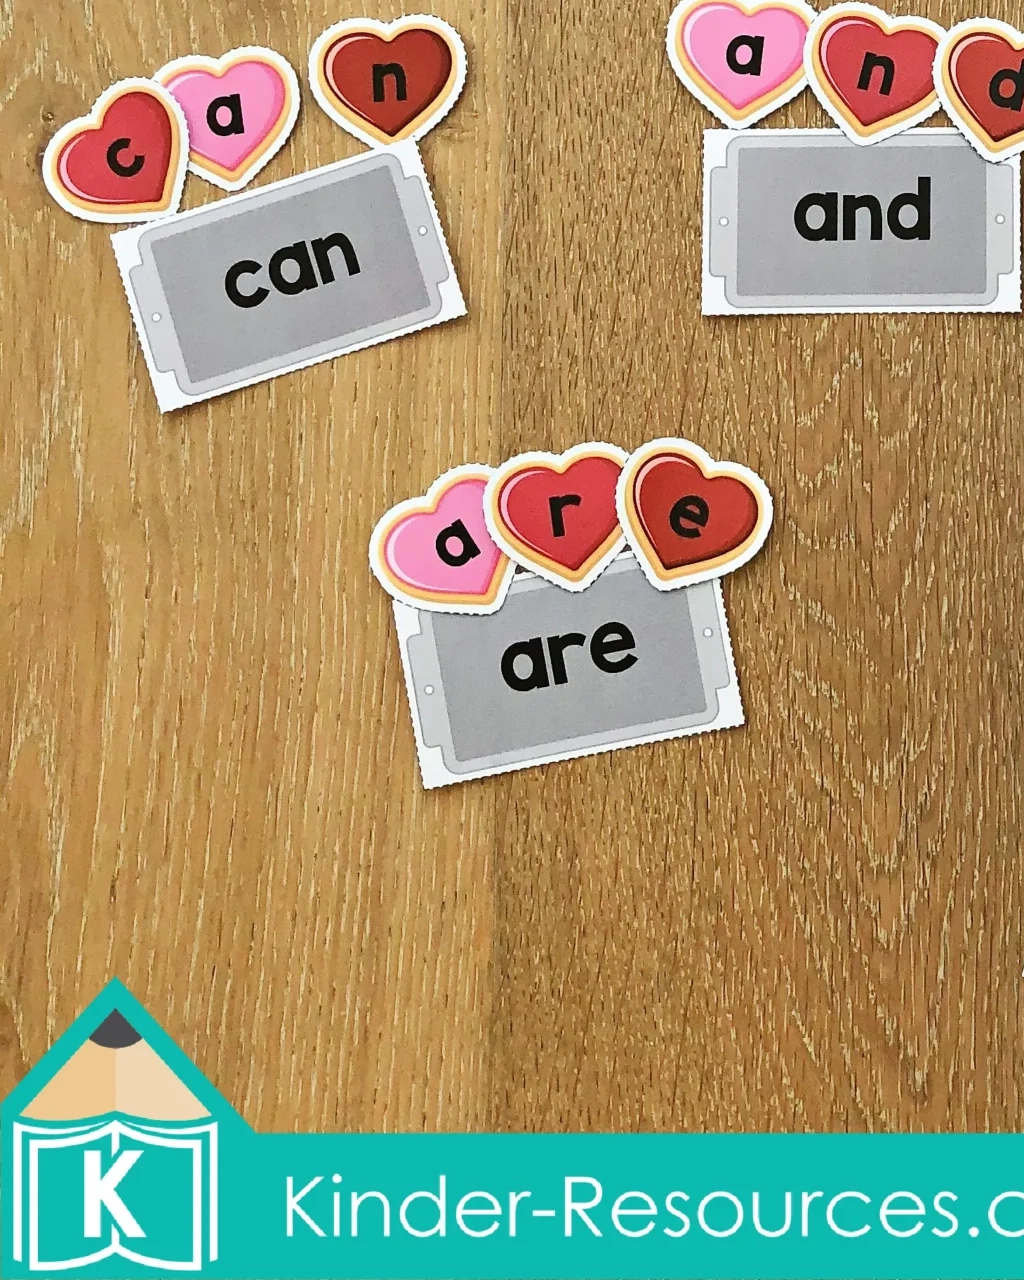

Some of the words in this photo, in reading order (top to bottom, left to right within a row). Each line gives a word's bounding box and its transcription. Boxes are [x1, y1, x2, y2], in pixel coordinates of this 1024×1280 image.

[725, 33, 764, 77] a
[857, 52, 895, 96] n
[106, 137, 145, 178] c
[205, 93, 244, 137] a
[372, 62, 407, 102] n
[793, 176, 931, 241] and
[225, 232, 361, 308] can
[435, 519, 482, 567] a
[548, 493, 581, 538] r
[669, 495, 710, 538] e
[500, 621, 638, 691] are
